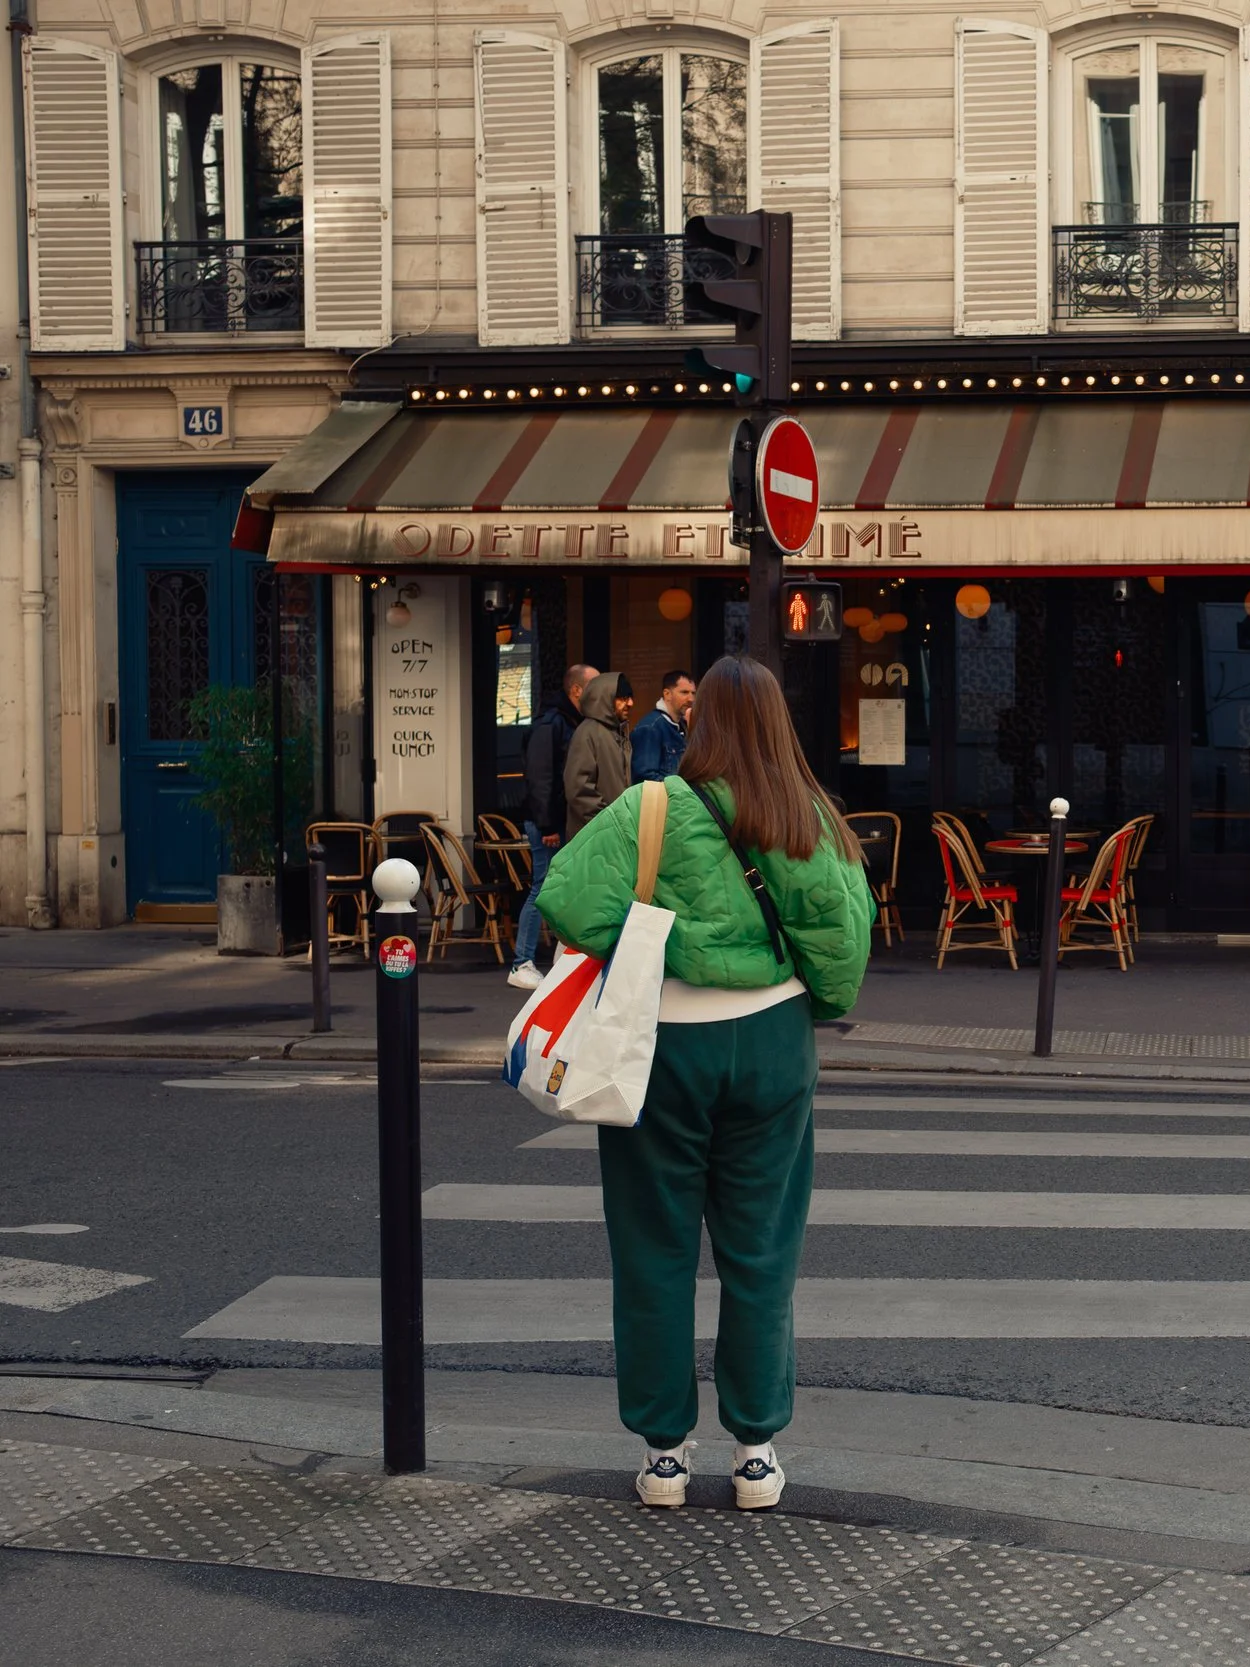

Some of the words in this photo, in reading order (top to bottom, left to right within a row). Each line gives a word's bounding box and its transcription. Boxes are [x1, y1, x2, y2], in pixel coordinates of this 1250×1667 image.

[188, 409, 217, 433] 46
[392, 523, 630, 559] ODETTE
[662, 523, 730, 559] ET
[797, 516, 922, 559] IMÉ
[391, 639, 433, 654] OPEN
[402, 660, 428, 673] 7/7
[392, 706, 435, 716] SERVICE
[393, 731, 433, 742] QUICK
[392, 743, 435, 758] LUNCH
